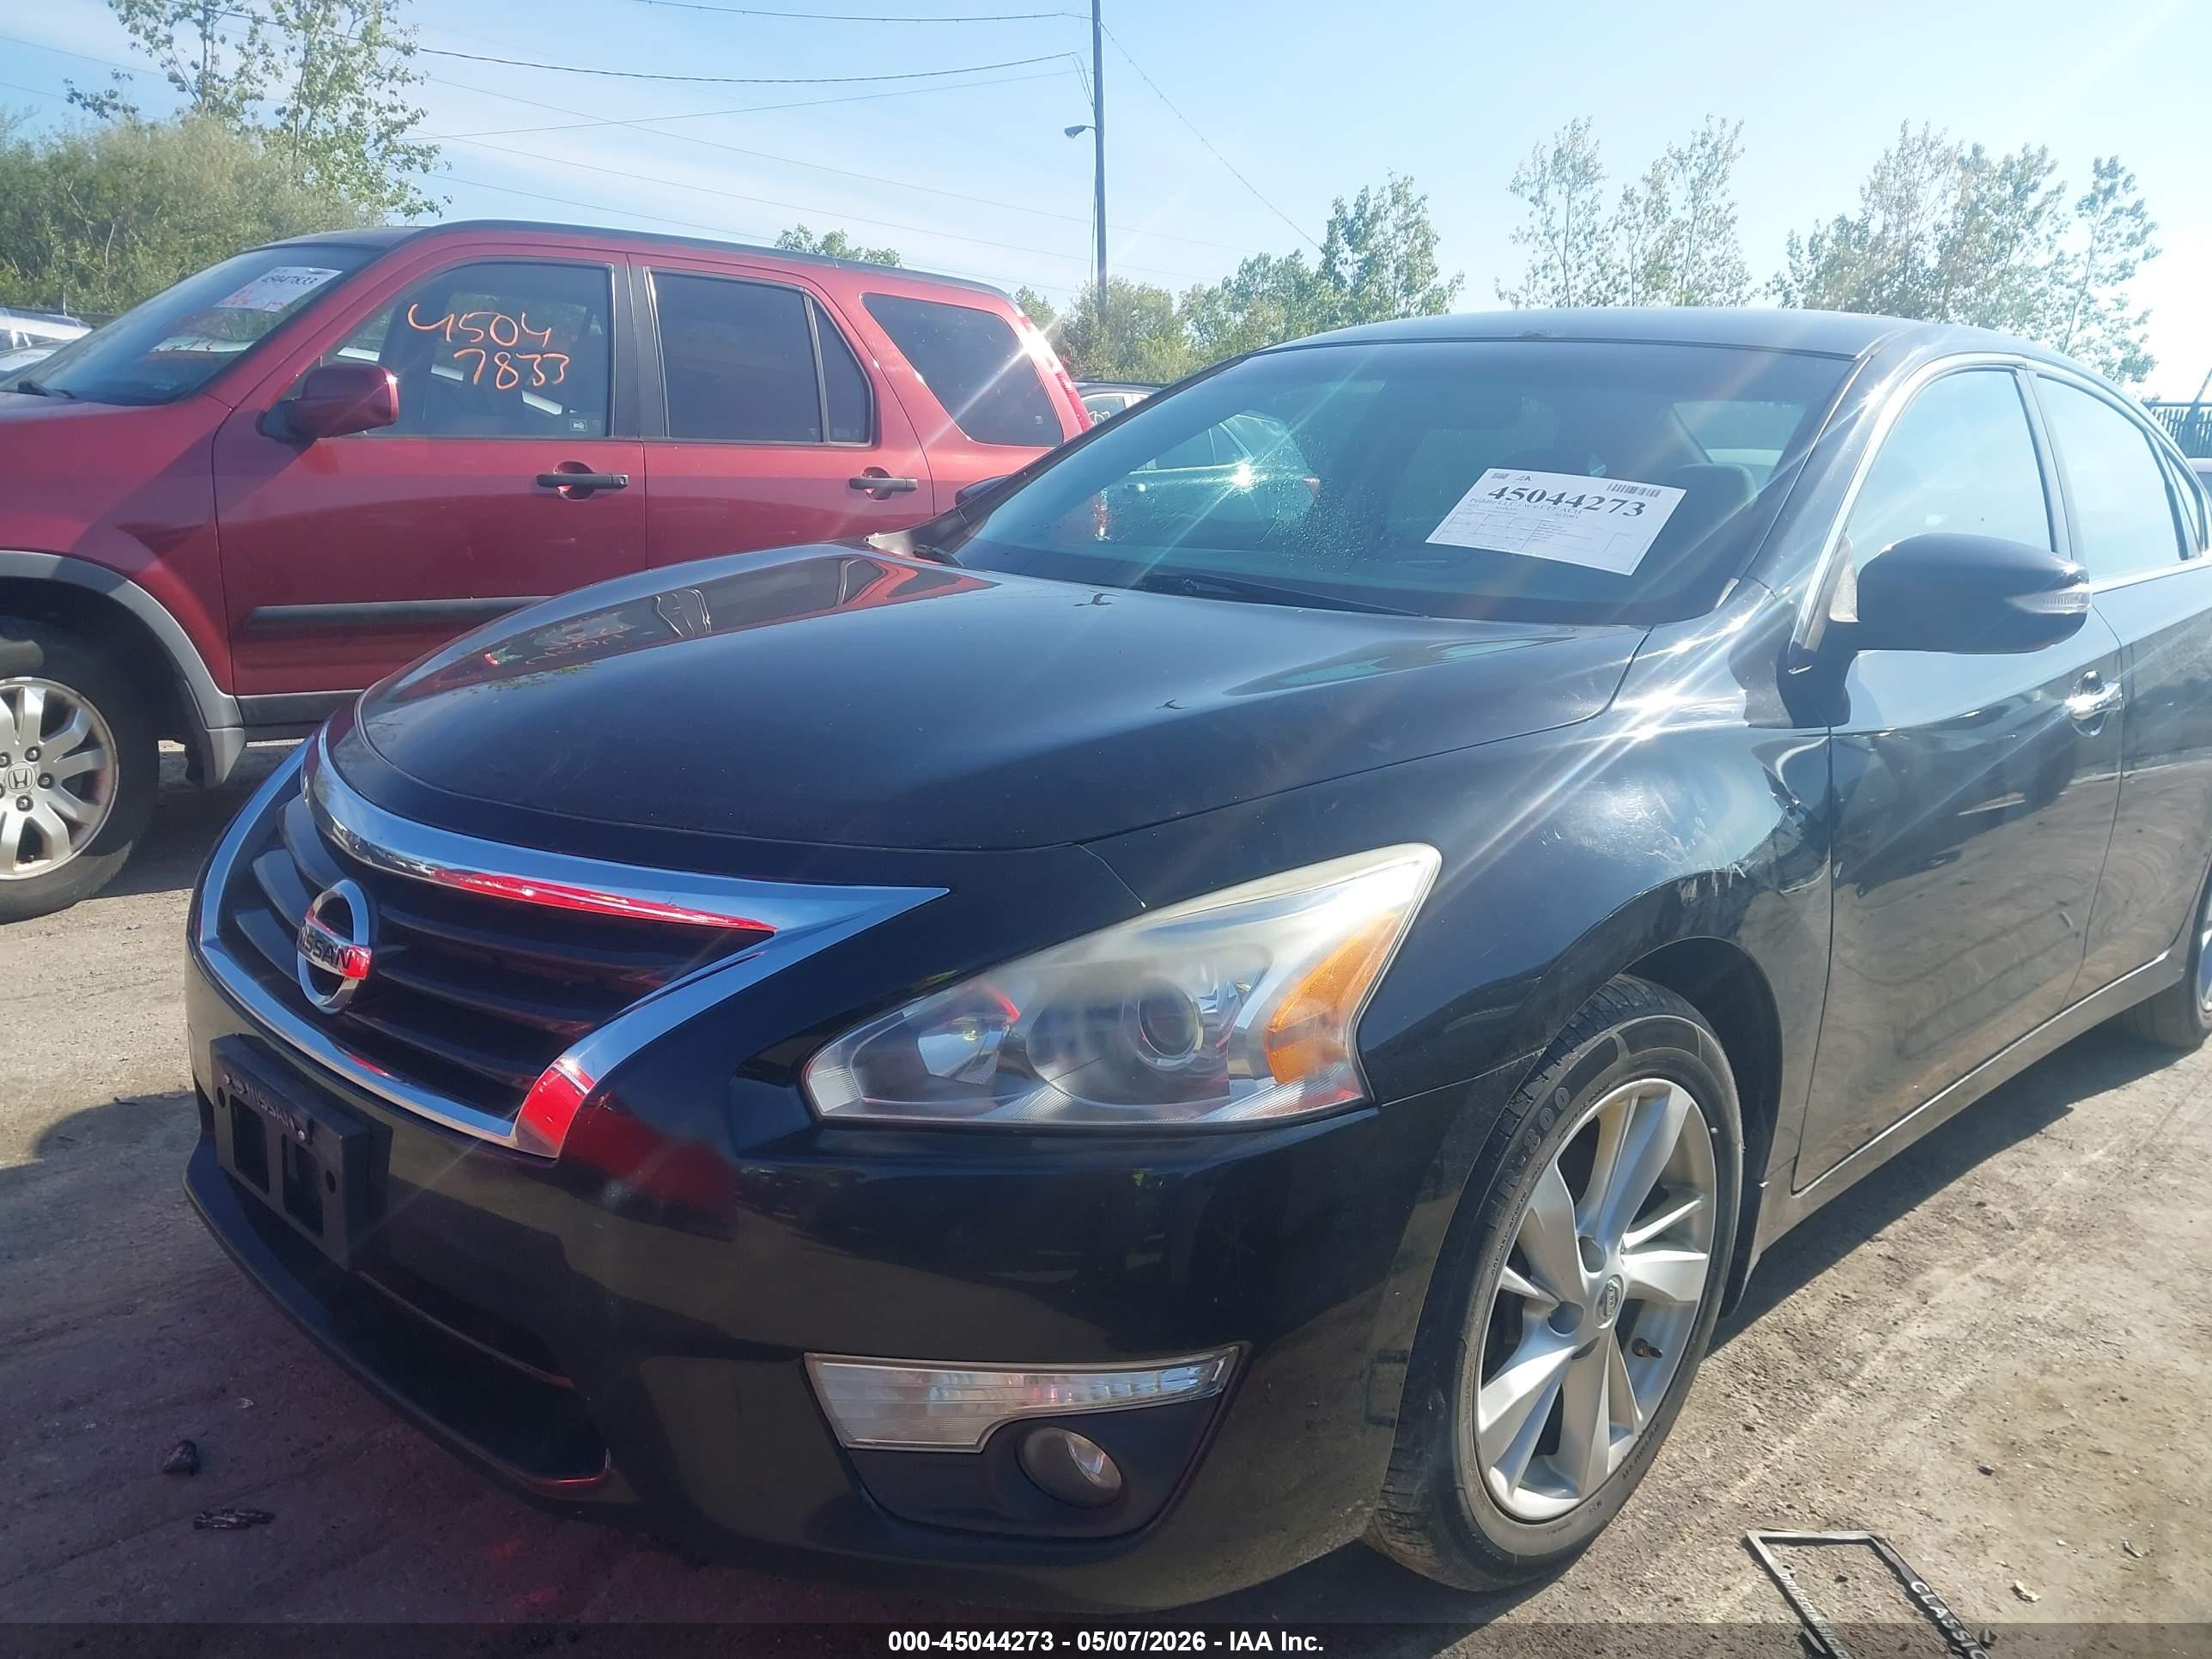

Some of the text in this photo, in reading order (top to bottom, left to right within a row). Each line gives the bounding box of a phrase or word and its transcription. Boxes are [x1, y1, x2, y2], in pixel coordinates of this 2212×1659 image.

[407, 303, 553, 347] 4504
[453, 348, 570, 390] 7833
[1487, 486, 1647, 517] 45044273
[299, 923, 354, 970] NISSAN
[1911, 1580, 1990, 1659] CLASSIC
